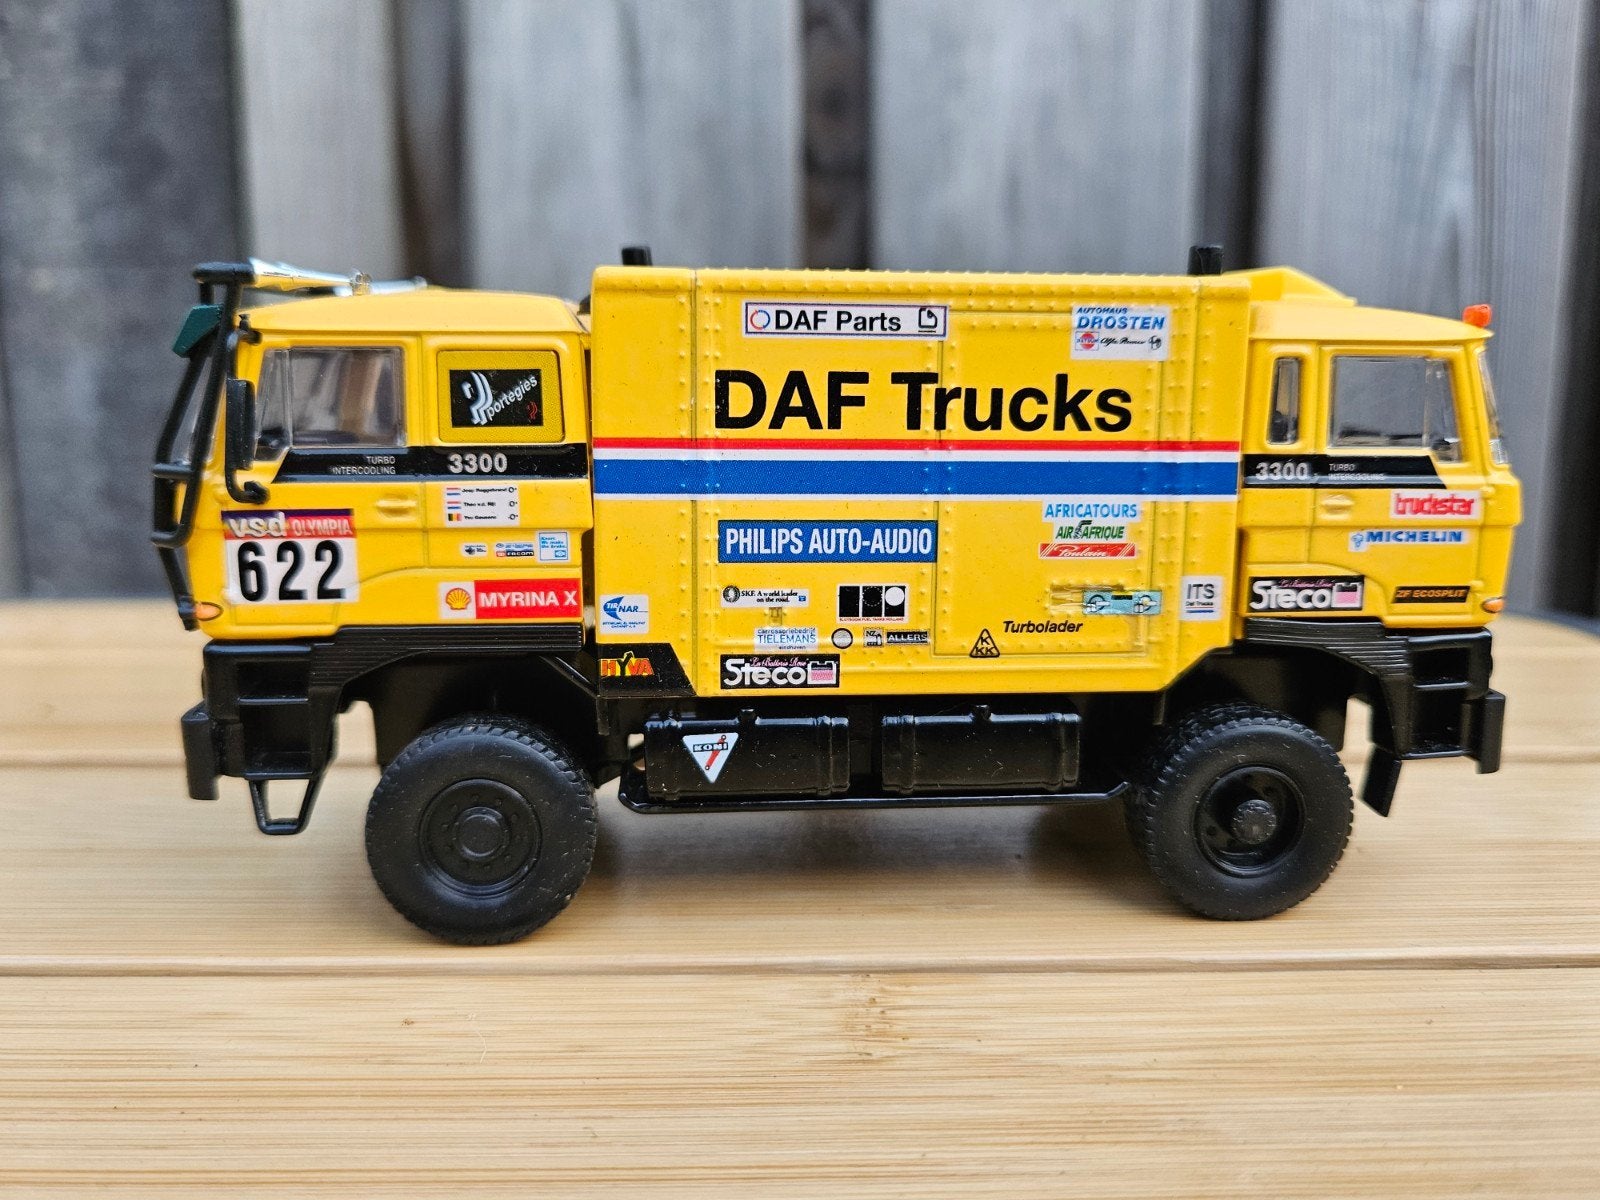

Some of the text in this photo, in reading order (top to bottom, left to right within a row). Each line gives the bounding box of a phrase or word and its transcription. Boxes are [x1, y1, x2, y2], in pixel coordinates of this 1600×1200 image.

[774, 309, 902, 332] DAF Parts
[1076, 315, 1165, 330] DROSTEN
[714, 369, 1132, 432] DAF Trucks
[366, 456, 396, 465] TURBO
[448, 453, 508, 475] 3300
[1328, 463, 1356, 472] TURBO
[332, 466, 396, 475] INTERCOOLING
[1255, 461, 1309, 481] 3300
[1328, 473, 1385, 481] INTERCOOLING
[1045, 503, 1138, 518] AFRICATOURS
[1394, 493, 1475, 516] truckstar
[228, 511, 354, 538] vsd OLYMPIA
[726, 527, 932, 555] PHILIPS AUTO-AUDIO
[1056, 525, 1125, 541] AIR AFRIQUE
[1366, 531, 1462, 542] MICHELIN
[237, 540, 347, 602] 622
[478, 590, 578, 608] MYRINA X
[1186, 583, 1215, 600] ITS
[1249, 580, 1332, 610] Steco
[1395, 589, 1467, 598] ZF ECOSPLIT
[618, 605, 639, 613] NAR
[1003, 620, 1083, 633] Turbolader
[757, 634, 817, 644] TIELEMANS
[887, 633, 928, 642] ALLERS
[600, 650, 655, 677] HYVA
[723, 658, 807, 686] Steco
[693, 743, 728, 752] KONI
